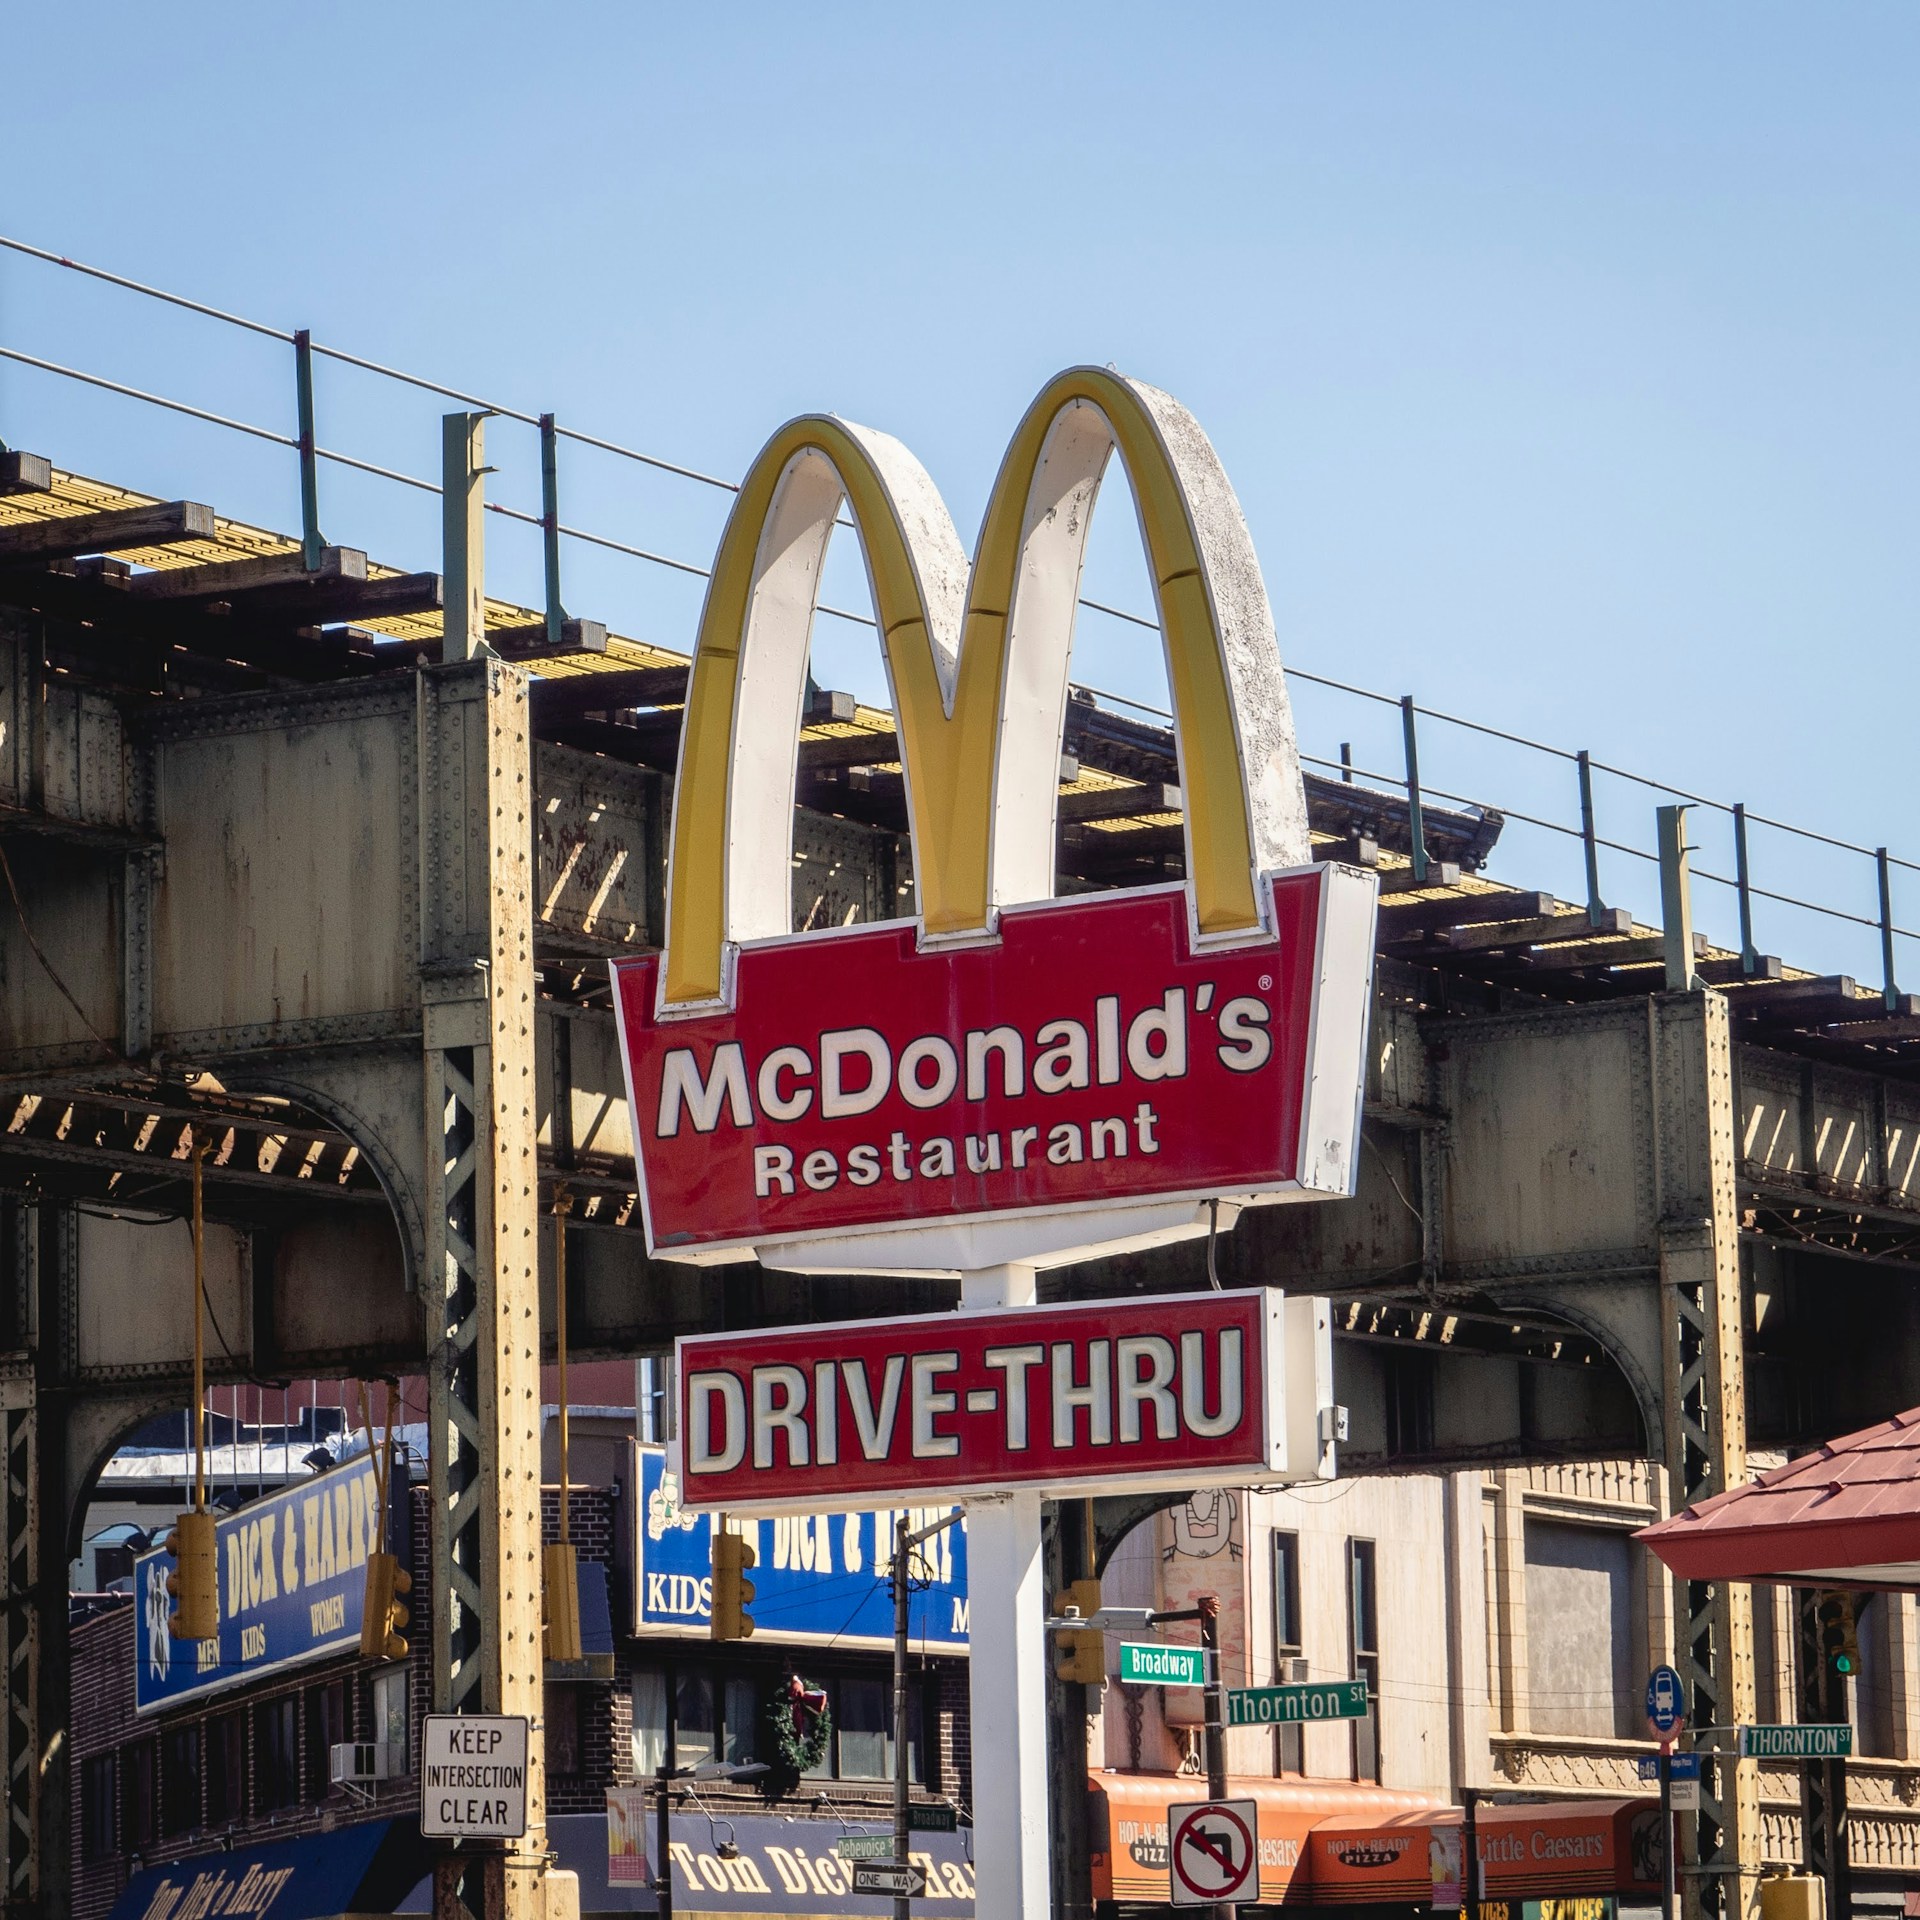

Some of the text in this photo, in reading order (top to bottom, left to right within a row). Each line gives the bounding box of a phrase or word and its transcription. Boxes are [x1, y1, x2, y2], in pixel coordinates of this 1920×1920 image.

[656, 982, 1273, 1138] McDonald's
[753, 1103, 1159, 1197] Restaurant
[688, 1328, 1244, 1475] DRIVE-THRU
[227, 1513, 278, 1619] DICK
[282, 1504, 299, 1595] &
[647, 1572, 712, 1616] KIDS
[197, 1594, 345, 1674] MEN KIDS WOMEN
[1132, 1648, 1194, 1682] Broadway
[1230, 1684, 1364, 1723] Thornton St
[449, 1729, 503, 1754] KEEP
[1750, 1728, 1851, 1754] THORNTON ST
[427, 1765, 522, 1788] INTERSECTION
[1639, 1761, 1657, 1778] B46
[440, 1798, 508, 1825] CLEAR
[913, 1810, 950, 1831] Broadway
[838, 1837, 885, 1857] Debevoise
[1118, 1820, 1169, 1846] HOT-N-RE
[1327, 1837, 1411, 1855] HOT-N-READY
[1475, 1832, 1525, 1863] Little
[1530, 1829, 1603, 1861] Caesars
[1134, 1847, 1169, 1862] PIZZ
[1258, 1838, 1299, 1867] aesars
[1345, 1853, 1392, 1864] PIZZA
[669, 1843, 772, 1893] Tom
[859, 1873, 916, 1888] ONE WAY
[141, 1878, 184, 1920] Tom
[171, 1868, 227, 1920] Dick
[222, 1862, 295, 1920] Harry
